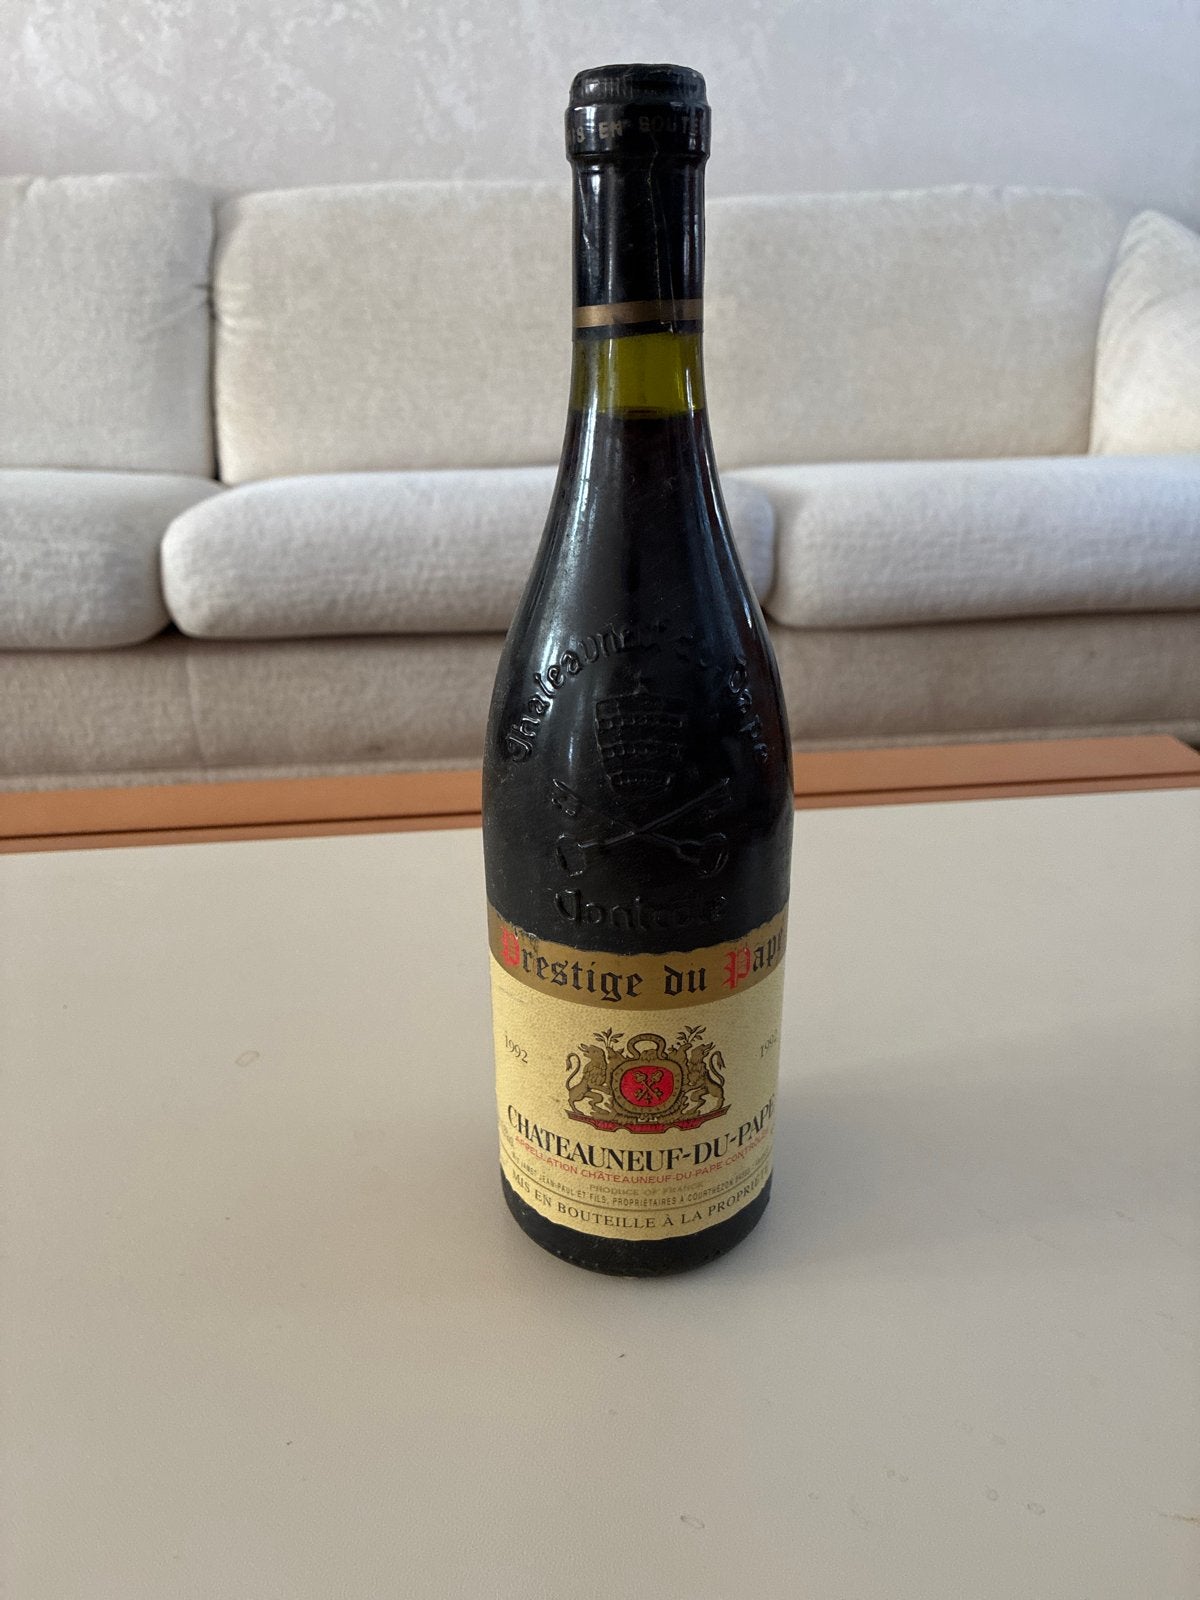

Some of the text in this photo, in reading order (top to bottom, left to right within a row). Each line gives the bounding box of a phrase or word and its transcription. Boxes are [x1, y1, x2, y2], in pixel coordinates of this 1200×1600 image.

[500, 926, 644, 1002] Prestige
[664, 965, 708, 996] du
[505, 1034, 528, 1064] 1992
[512, 1168, 531, 1194] MIS
[534, 1189, 553, 1208] EN
[557, 1202, 656, 1229] BOUTEILLE
[662, 1213, 675, 1227] À
[681, 1209, 703, 1225] LA
